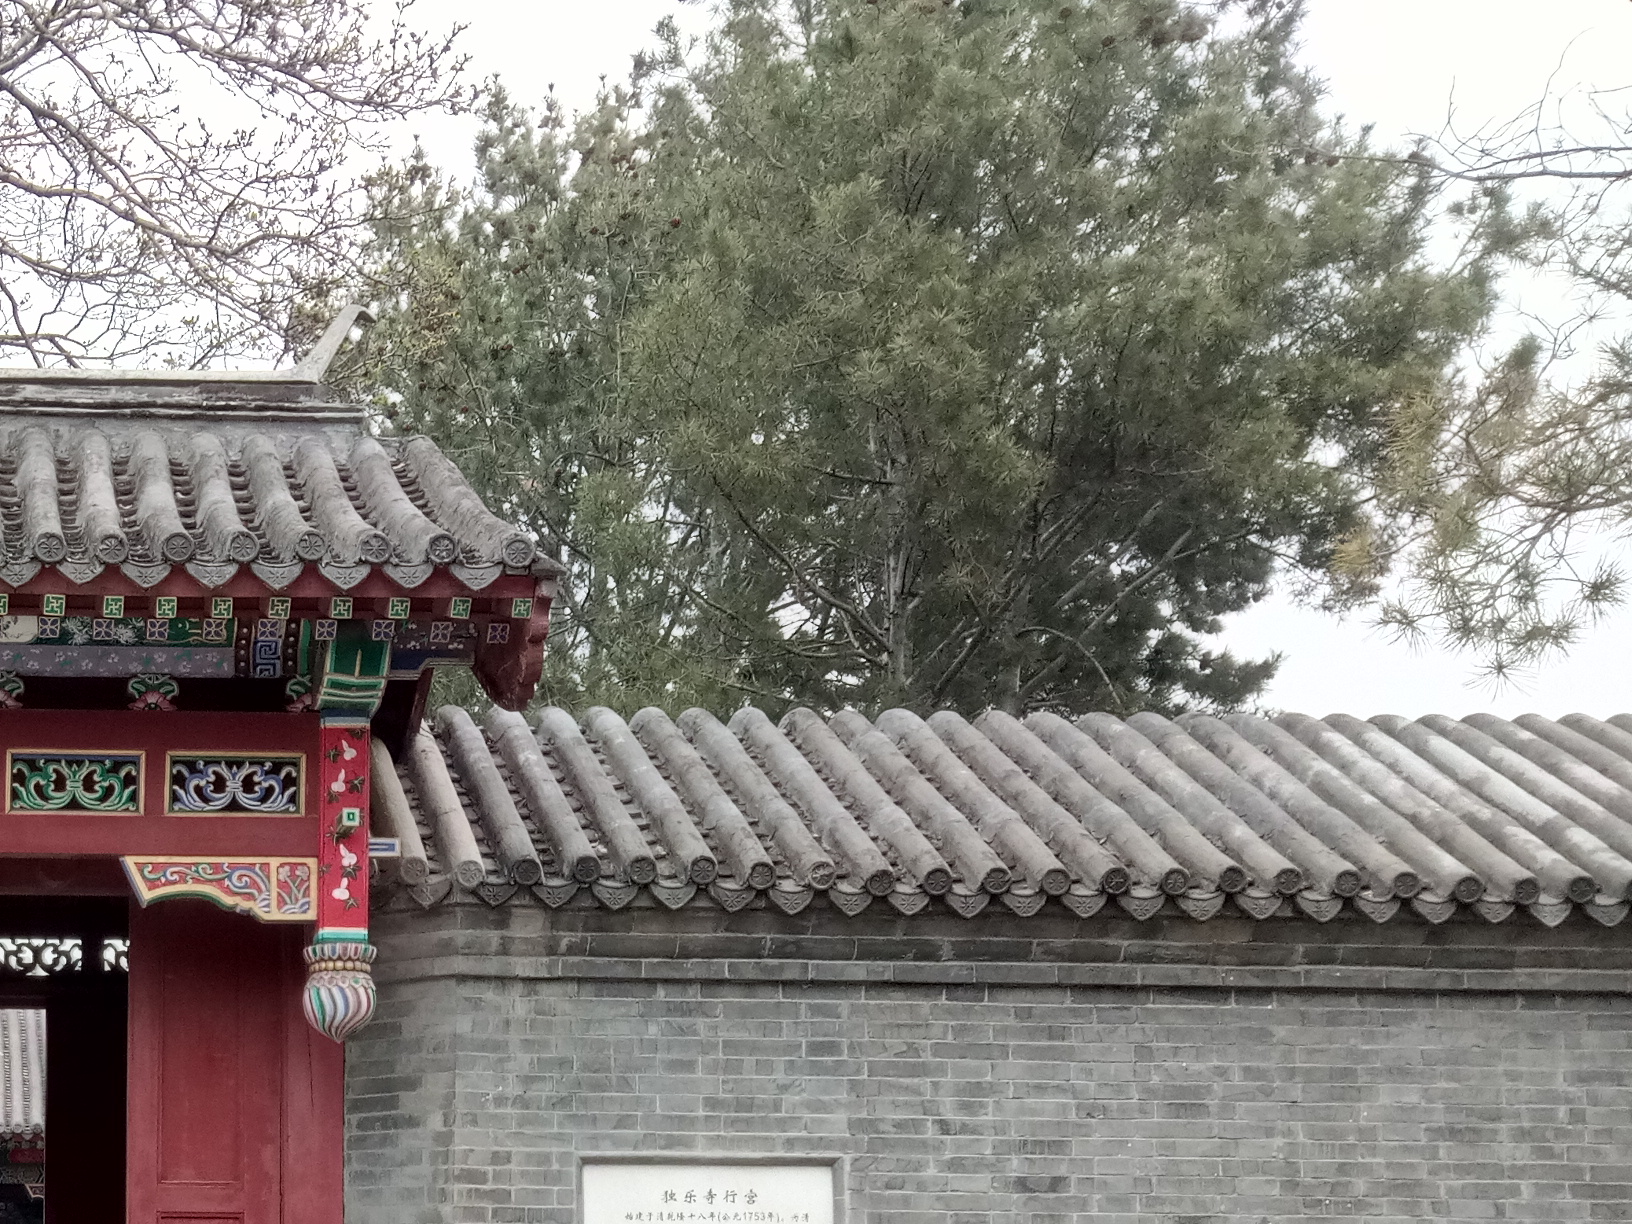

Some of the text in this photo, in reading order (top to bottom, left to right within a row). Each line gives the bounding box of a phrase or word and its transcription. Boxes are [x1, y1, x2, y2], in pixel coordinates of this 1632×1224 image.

[661, 1188, 758, 1205] 独乐寺行宫
